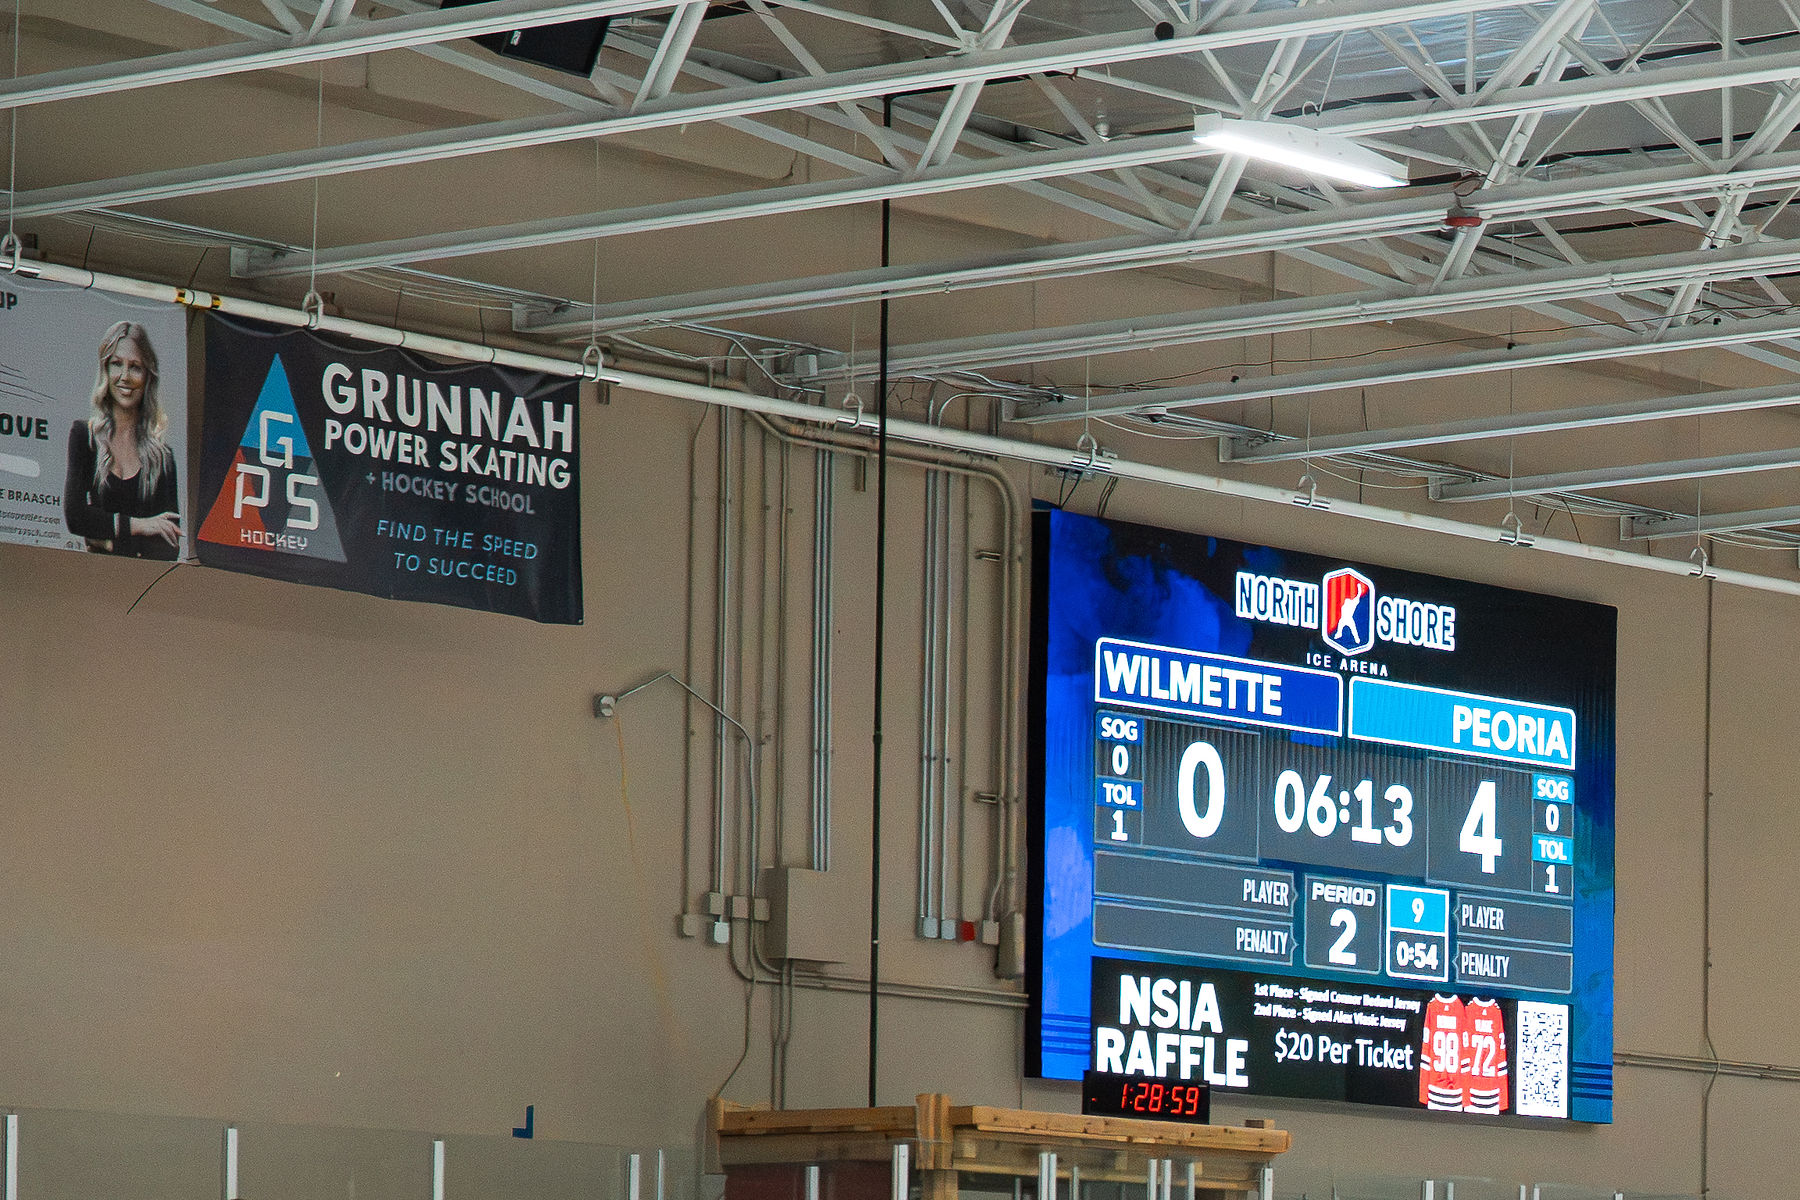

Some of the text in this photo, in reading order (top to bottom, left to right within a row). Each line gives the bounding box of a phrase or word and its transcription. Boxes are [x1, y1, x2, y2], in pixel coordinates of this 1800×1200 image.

[321, 361, 574, 454] GRUNNAH
[323, 417, 572, 490] POWER SKATING
[8, 489, 61, 507] BRAASCH
[381, 470, 458, 505] HOCKEY
[464, 481, 535, 516] SCHOOL
[239, 527, 309, 551] HOCKEY
[376, 519, 539, 561] FIND THE SPEED
[394, 552, 518, 587] TO SUCCEED
[1236, 571, 1456, 652] NORTH SHORE
[1306, 652, 1388, 677] ICE ARENA
[1103, 648, 1284, 717] WILMETTE
[1101, 716, 1138, 742] SOG
[1452, 704, 1570, 760] PEORIA
[1111, 744, 1129, 775] 0
[1102, 781, 1136, 807] TOL
[1177, 740, 1226, 839] 0
[1536, 777, 1569, 802] SOG
[1273, 768, 1413, 849] 06:13
[1545, 806, 1559, 833] 0
[1110, 809, 1128, 842] 1
[1459, 780, 1503, 875] 4
[1538, 838, 1568, 862] TOL
[1241, 876, 1290, 908] PLAYER
[1311, 881, 1376, 908] PERIOD
[1544, 863, 1559, 894] 1
[1411, 896, 1424, 924] 9
[1461, 903, 1505, 932] PLAYER
[1235, 926, 1289, 956] PENALTY
[1328, 907, 1358, 967] 2
[1396, 939, 1440, 972] 0:54
[1460, 945, 1510, 979] PENALTY
[1118, 972, 1223, 1034] NSIA
[1299, 987, 1329, 1004] Signed
[1302, 1007, 1333, 1024] Signed
[1096, 1026, 1250, 1089] RAFFLE
[1274, 1027, 1414, 1071] $20 Per Ticket
[1433, 1031, 1460, 1074] 98
[1471, 1035, 1497, 1078] 72
[1119, 1080, 1201, 1116] 1:28:59
